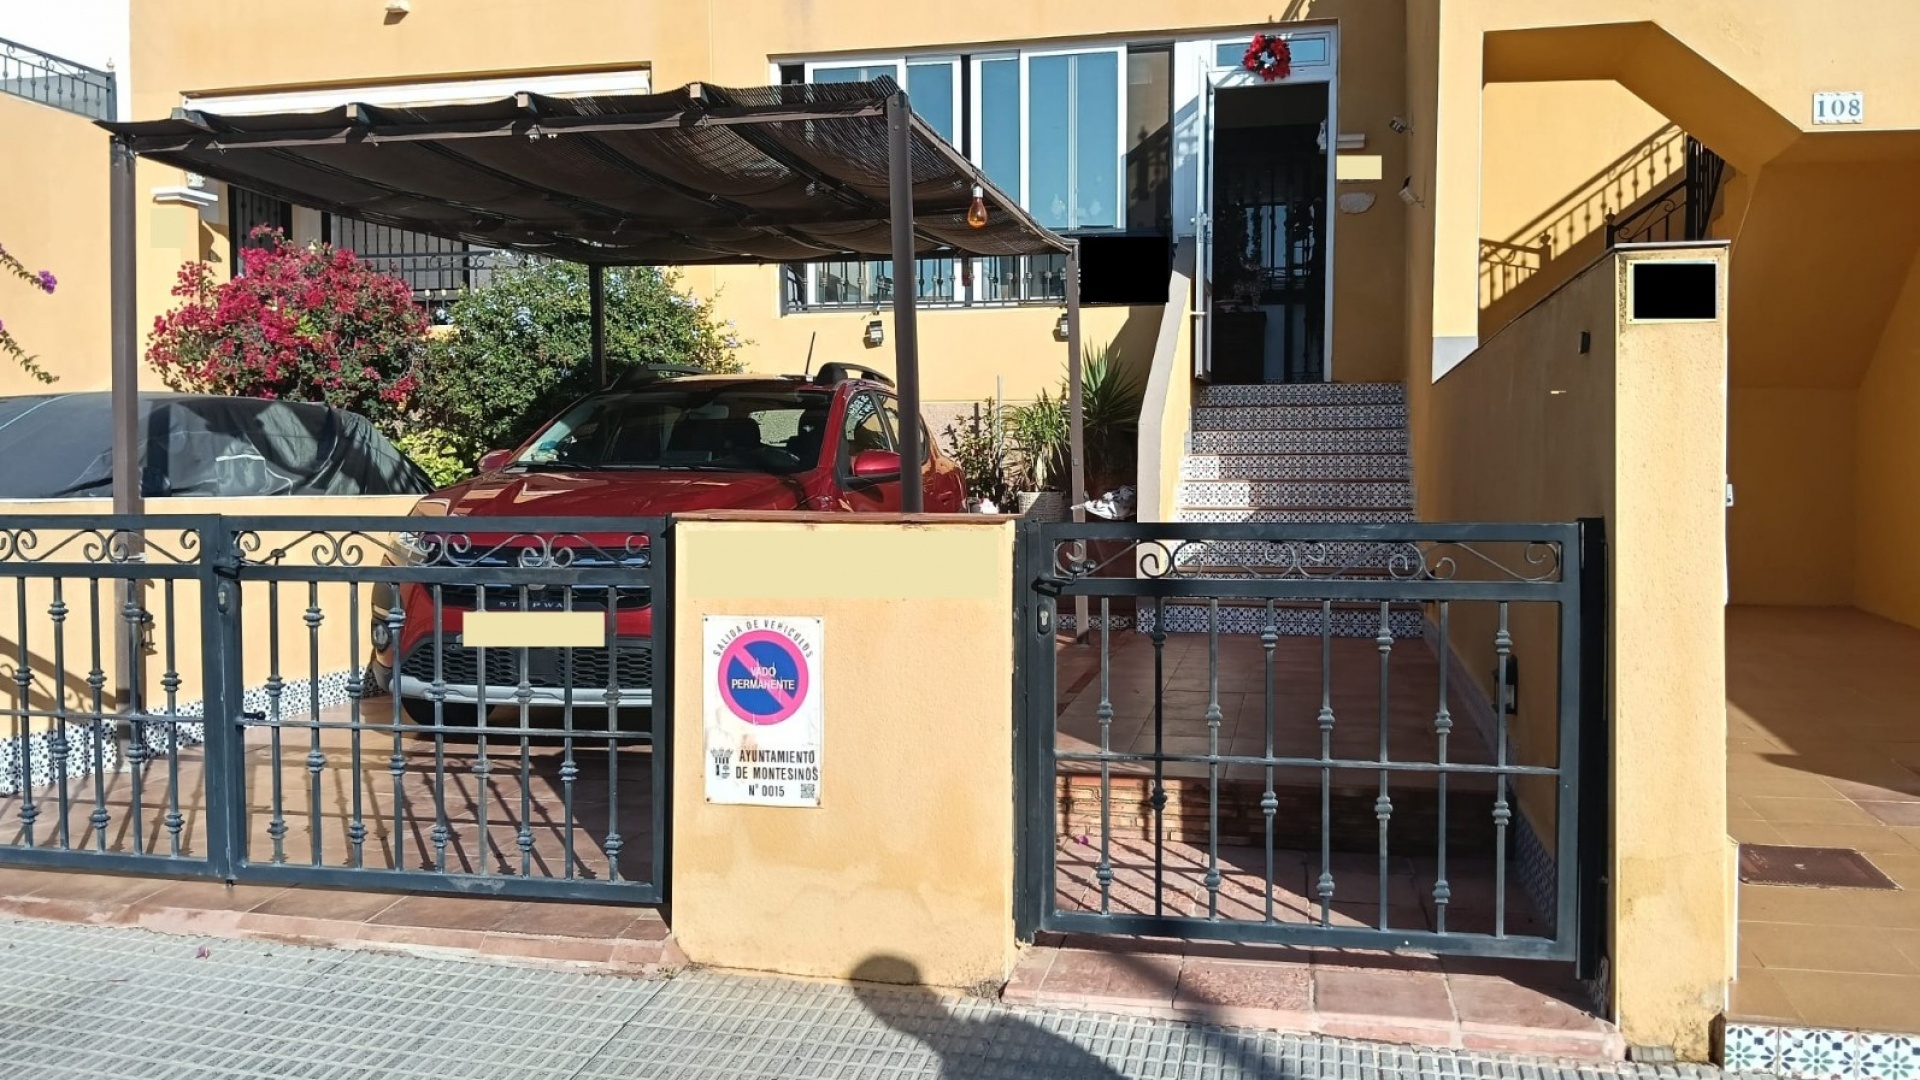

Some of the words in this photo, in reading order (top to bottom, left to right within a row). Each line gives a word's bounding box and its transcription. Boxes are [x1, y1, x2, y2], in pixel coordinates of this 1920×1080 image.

[1818, 99, 1861, 117] 108
[713, 625, 743, 656] SALIDA
[746, 619, 760, 629] DE
[764, 619, 813, 658] VEHICULOS
[751, 665, 777, 678] VADO
[731, 678, 796, 691] PERMANENTE
[739, 749, 815, 764] AYUNTAMIENTO
[735, 766, 748, 779] DE
[753, 766, 819, 781] MONTESINOS
[761, 785, 785, 798] 0015
